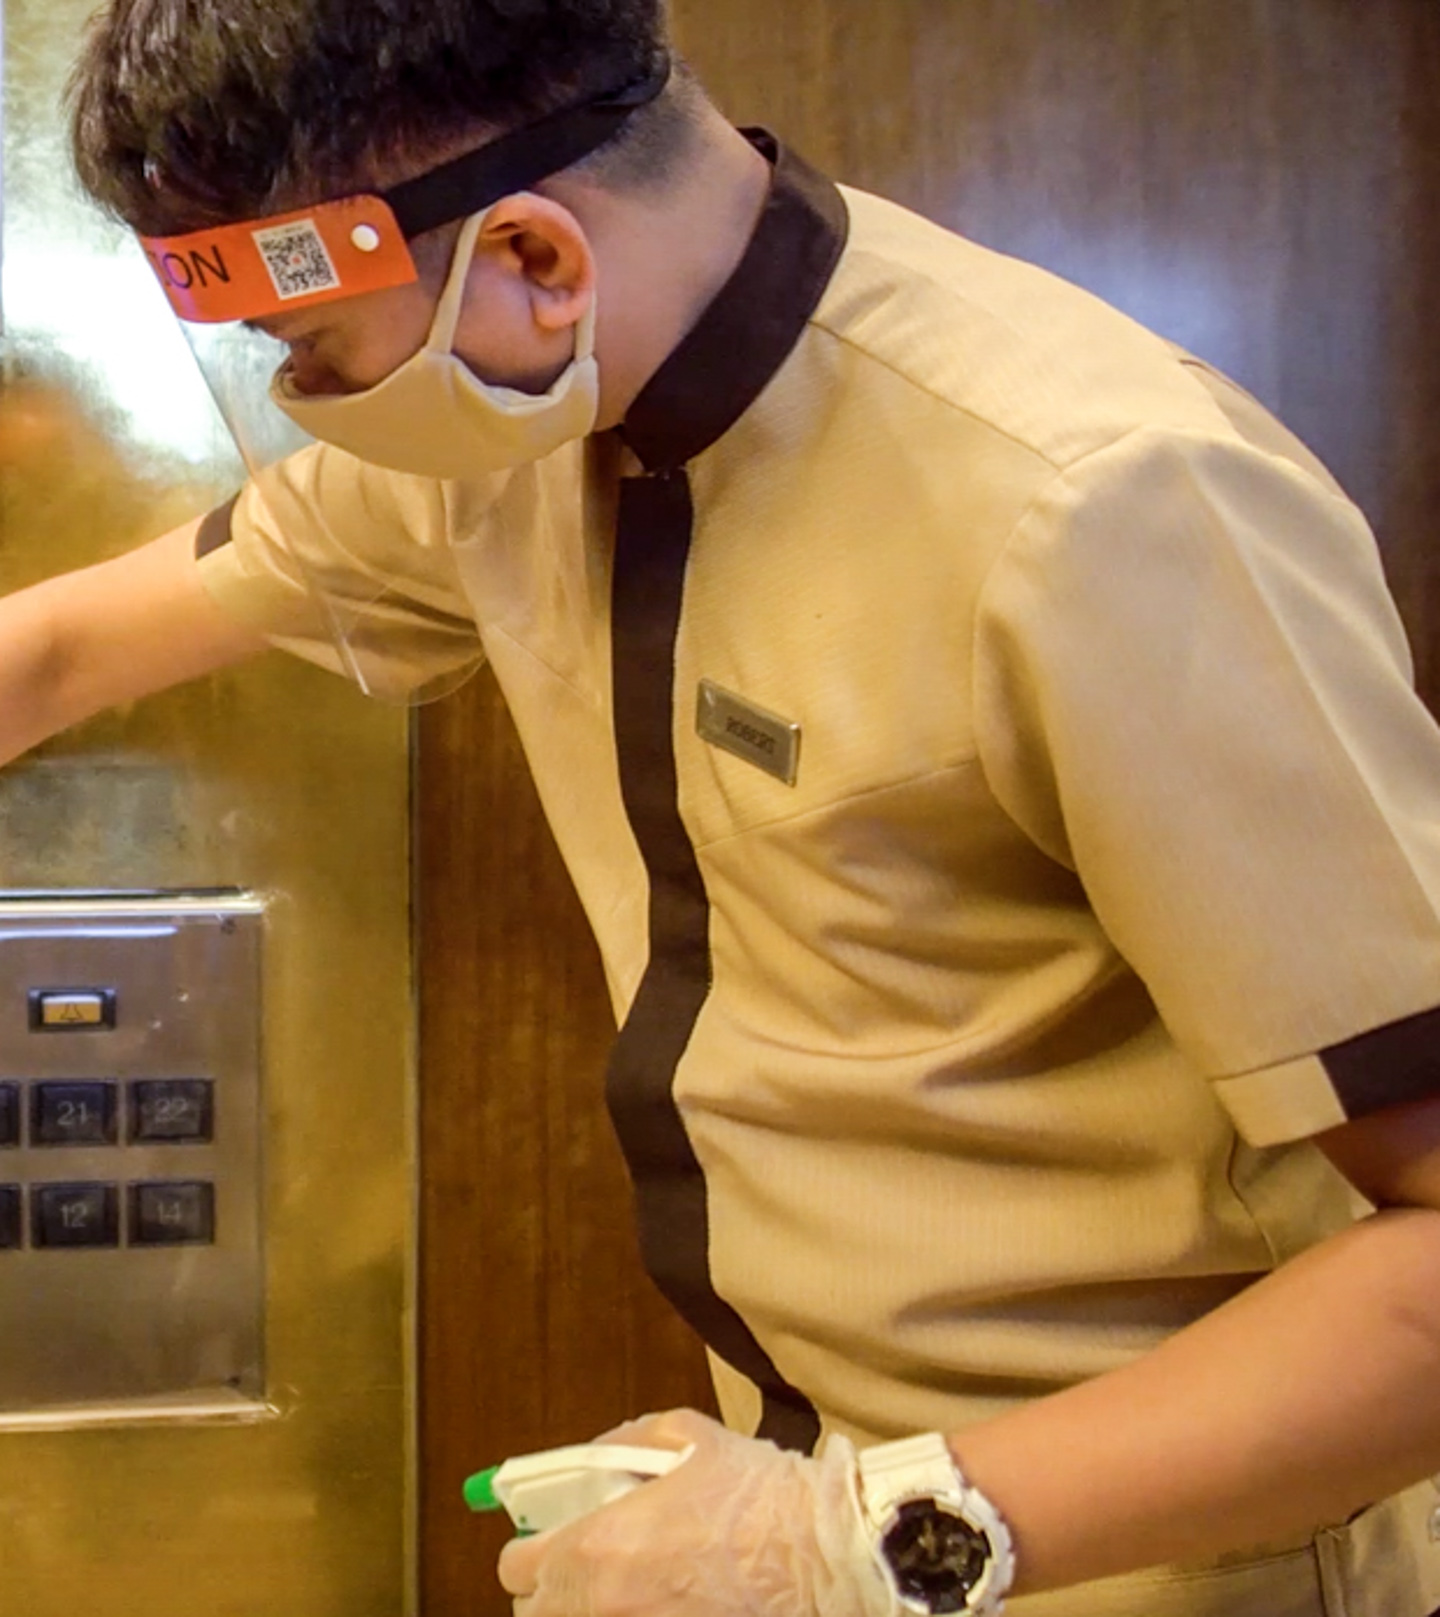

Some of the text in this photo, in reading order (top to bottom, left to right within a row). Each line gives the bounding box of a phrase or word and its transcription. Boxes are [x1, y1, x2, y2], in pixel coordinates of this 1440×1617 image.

[57, 1101, 89, 1126] 21
[154, 1097, 188, 1122] 22
[60, 1202, 88, 1227] 12
[157, 1200, 181, 1224] 14
